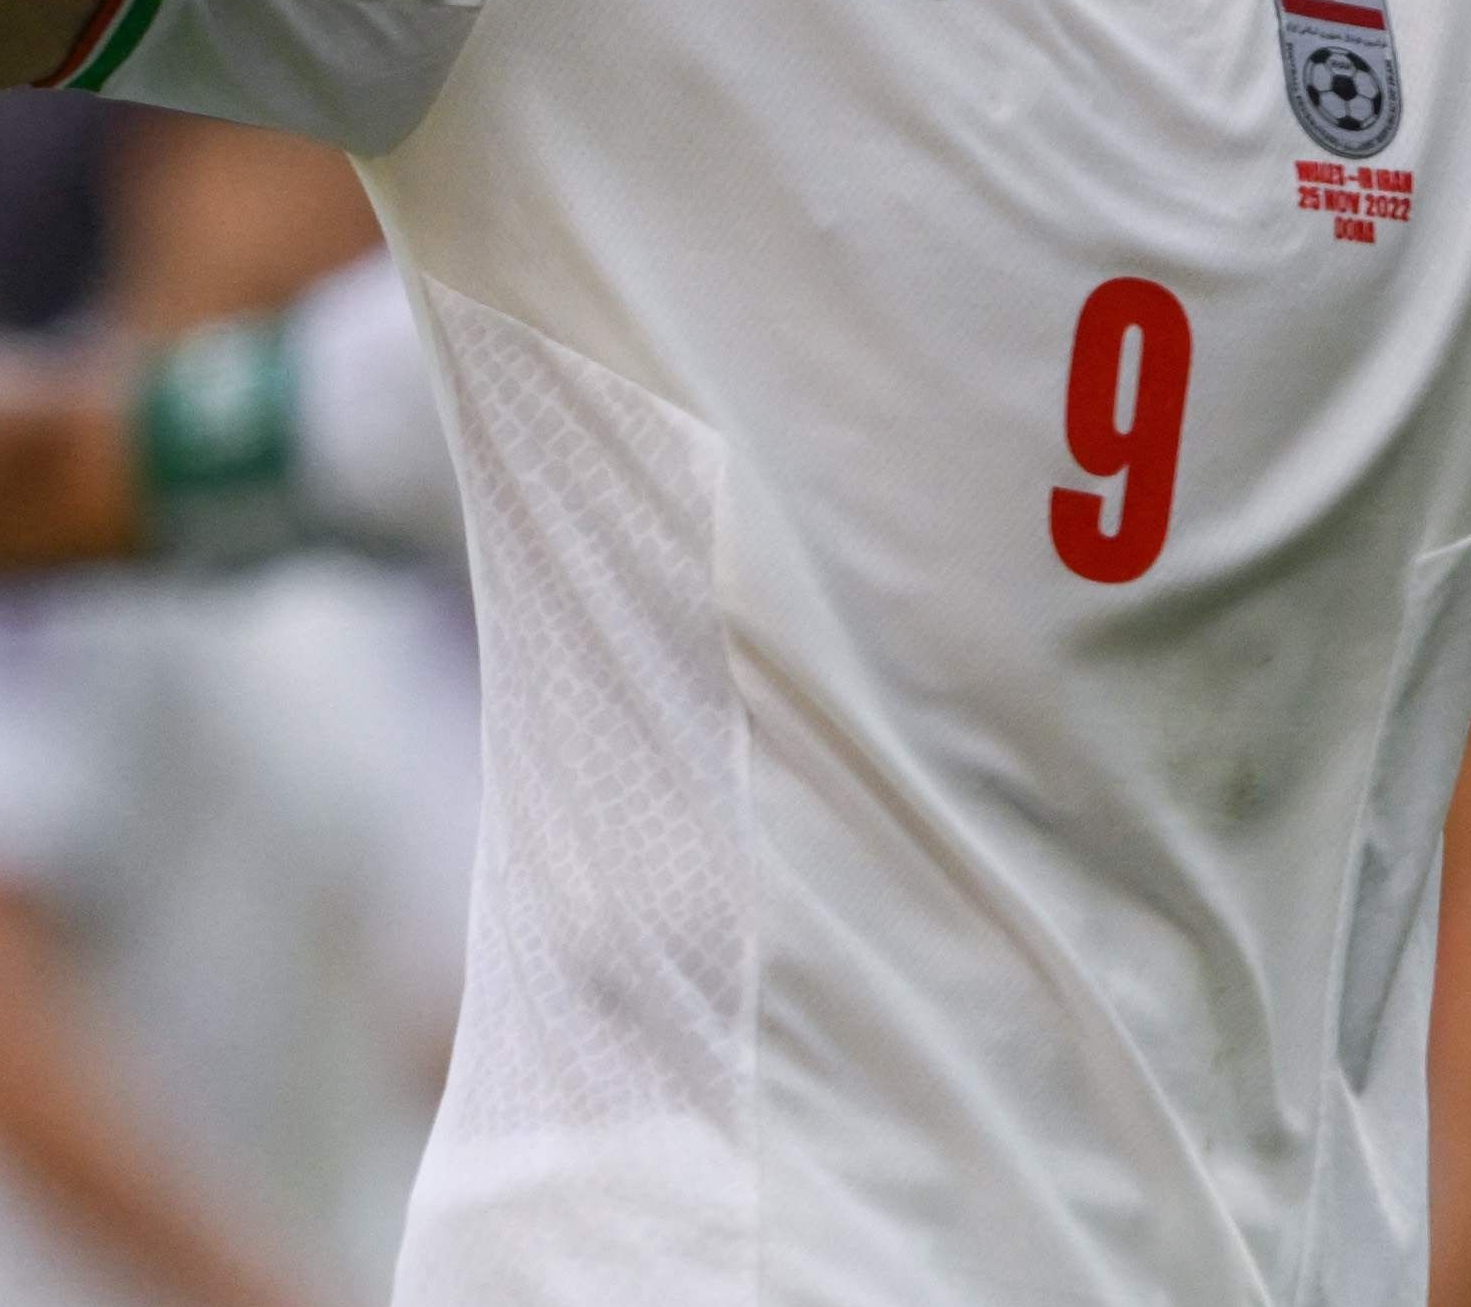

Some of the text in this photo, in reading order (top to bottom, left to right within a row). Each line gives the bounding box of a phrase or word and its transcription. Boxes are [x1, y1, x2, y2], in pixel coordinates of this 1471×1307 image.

[1298, 186, 1411, 222] 25 NOV 2022
[1048, 276, 1193, 584] 9
